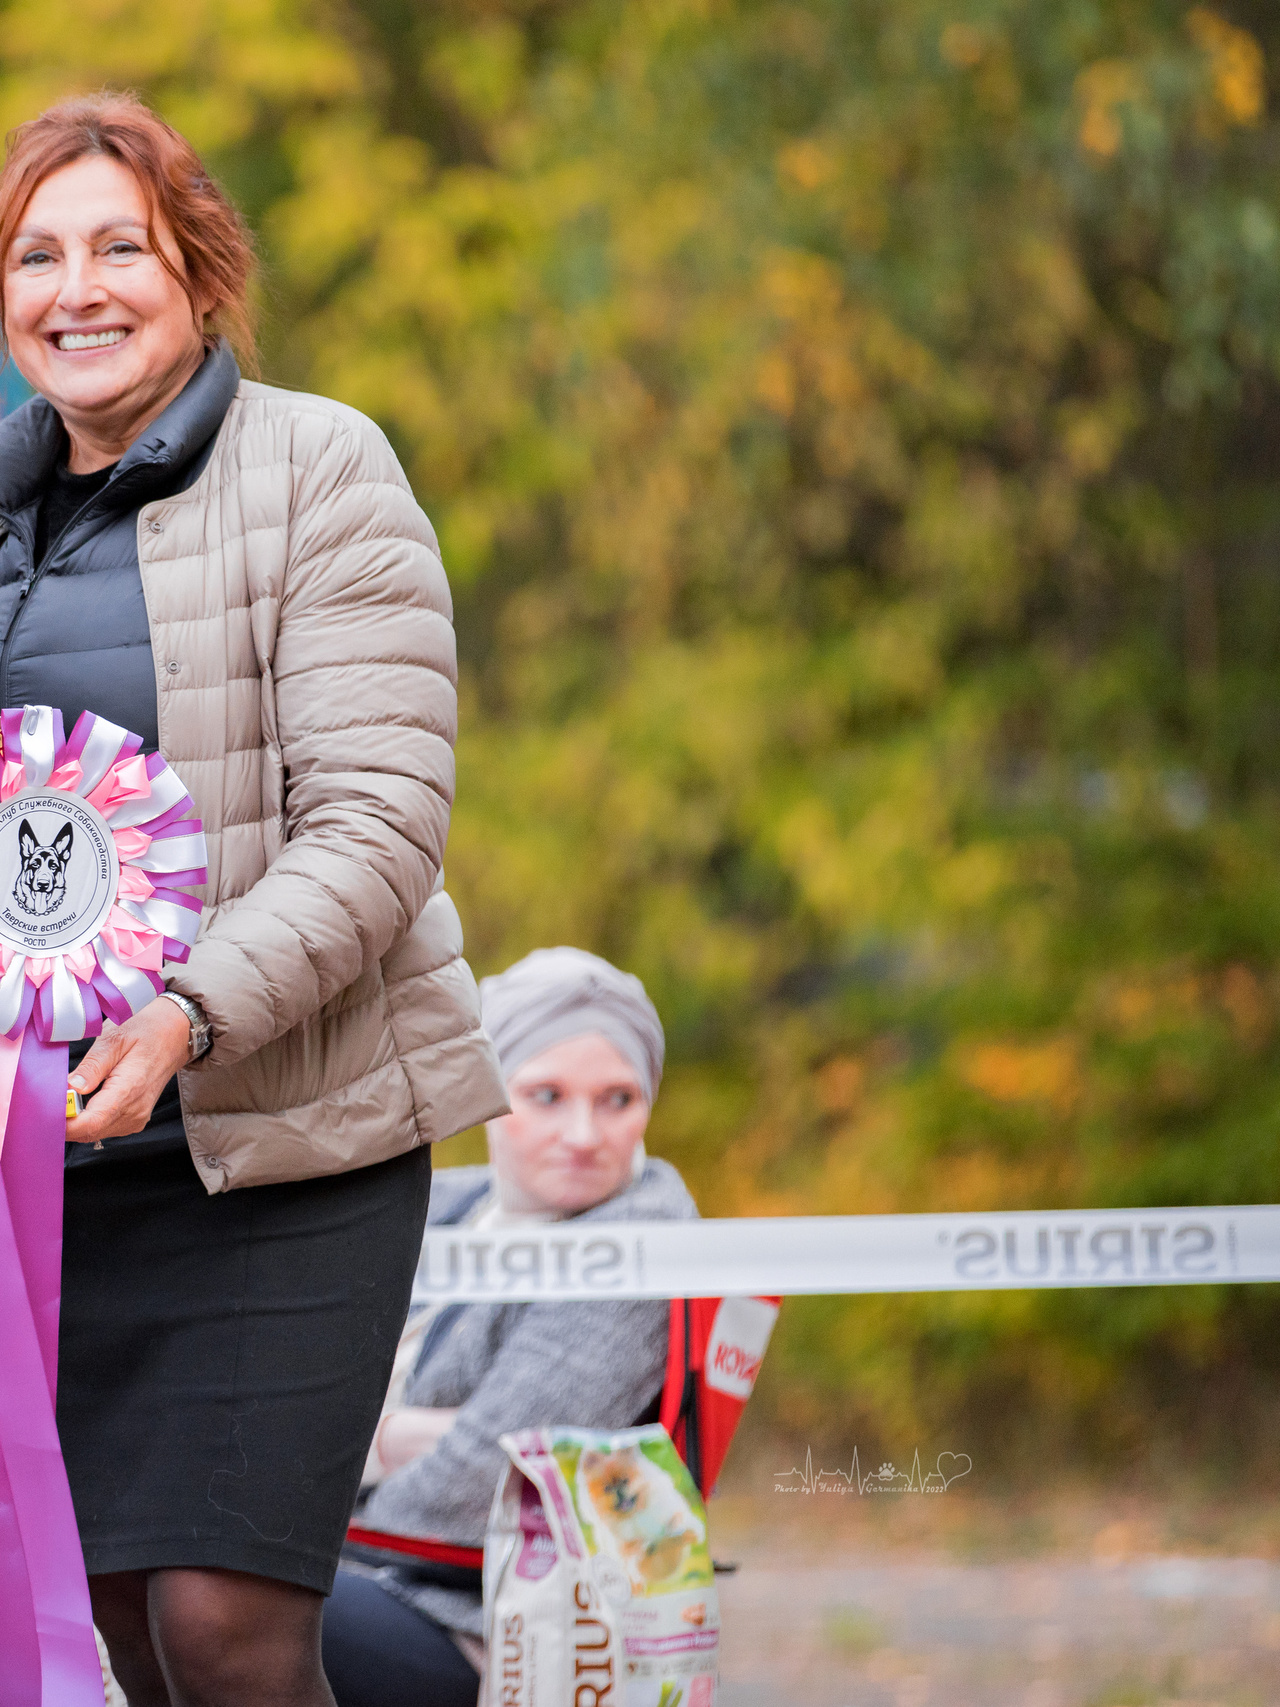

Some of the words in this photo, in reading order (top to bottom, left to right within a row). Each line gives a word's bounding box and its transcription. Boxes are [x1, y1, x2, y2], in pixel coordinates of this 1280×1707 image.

[18, 799, 73, 814] Служебного
[73, 810, 108, 880] Собаководства
[2, 907, 38, 932] Тверские
[40, 911, 77, 932] встречи
[24, 936, 47, 947] РОСТО
